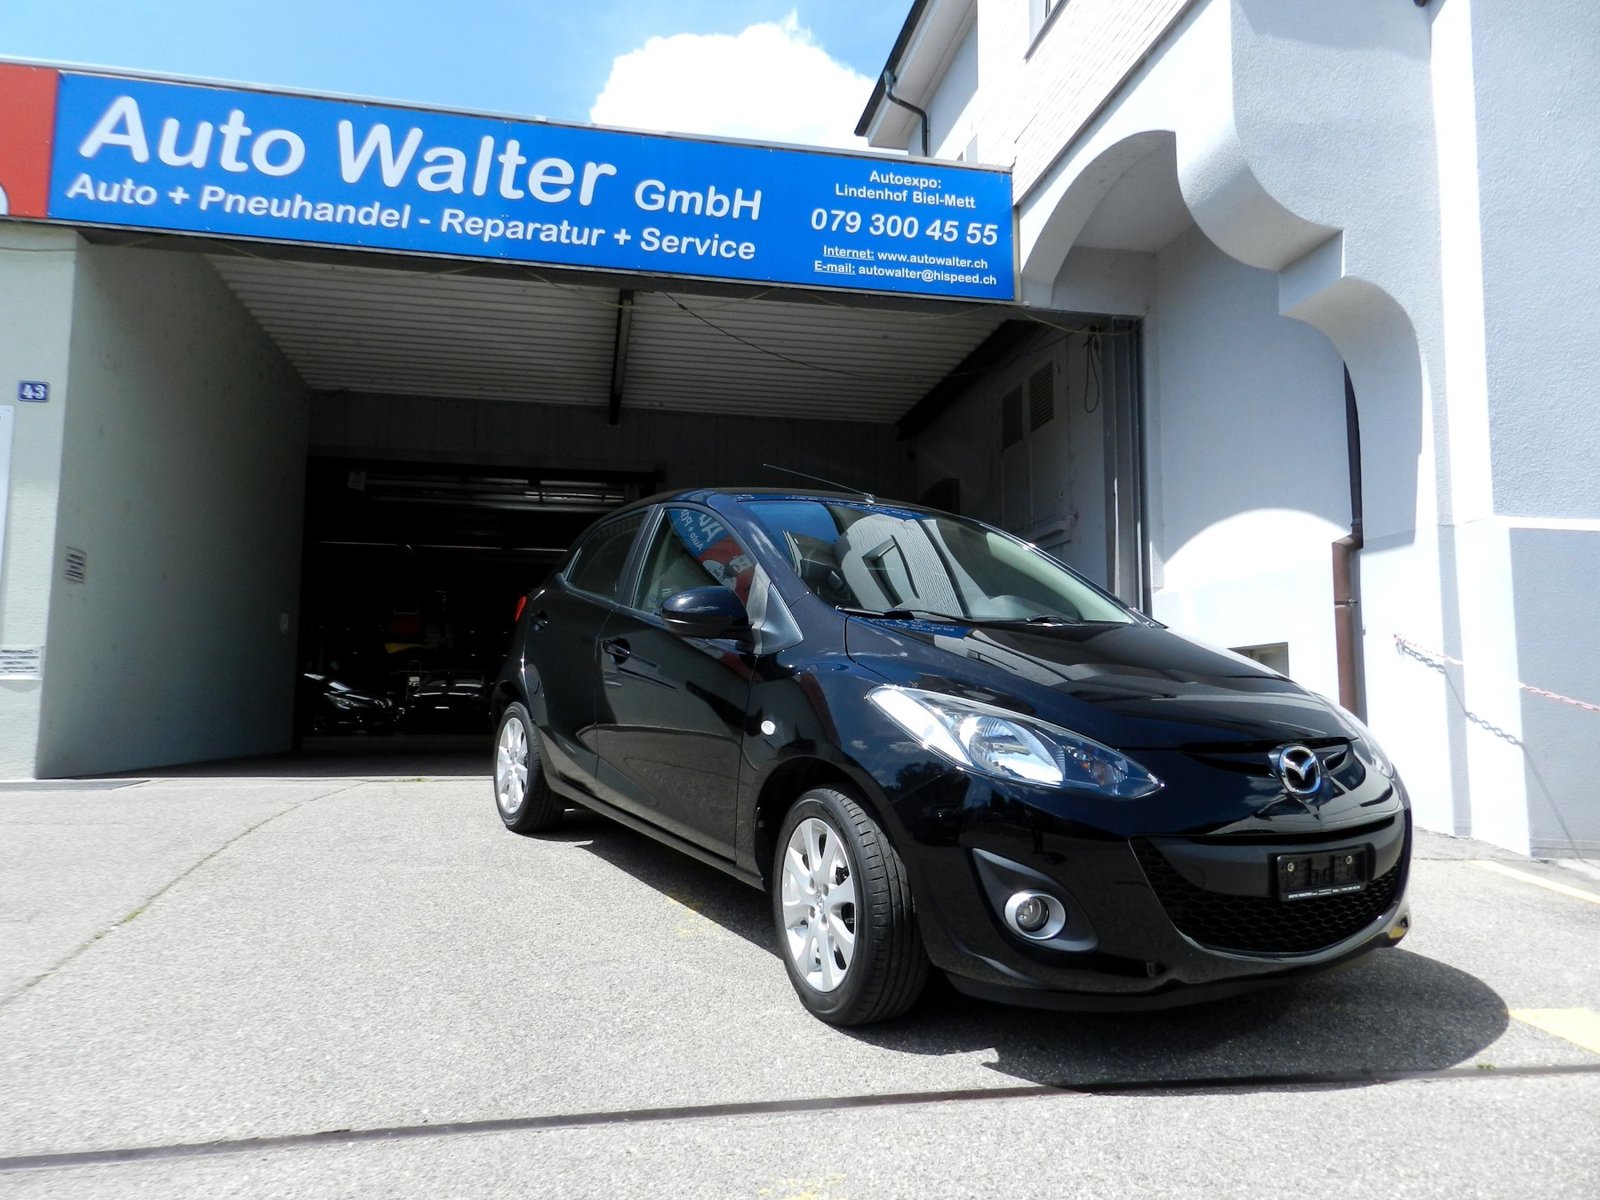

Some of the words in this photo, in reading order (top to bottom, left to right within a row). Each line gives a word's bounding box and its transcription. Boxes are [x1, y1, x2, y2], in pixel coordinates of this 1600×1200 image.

[79, 95, 306, 177] Auto
[337, 119, 618, 207] Walter
[634, 179, 763, 221] GmbH
[869, 170, 942, 190] Autoexpo:
[835, 183, 909, 203] Lindenhof
[912, 190, 977, 210] Biel-Mett
[66, 173, 158, 206] Auto
[168, 186, 190, 205] +
[199, 185, 411, 230] Pneuhandel
[440, 208, 606, 247] Reparatur
[613, 228, 631, 246] +
[640, 227, 757, 261] Service
[811, 207, 863, 234] 079
[869, 213, 919, 239] 300
[925, 218, 960, 243] 45
[966, 222, 998, 246] 55
[823, 244, 876, 261] Internet:
[877, 251, 989, 270] www.autowalter.ch
[814, 260, 856, 276] E-mail:
[858, 264, 998, 286] autowalter@hispeed.ch
[23, 385, 46, 400] 43
